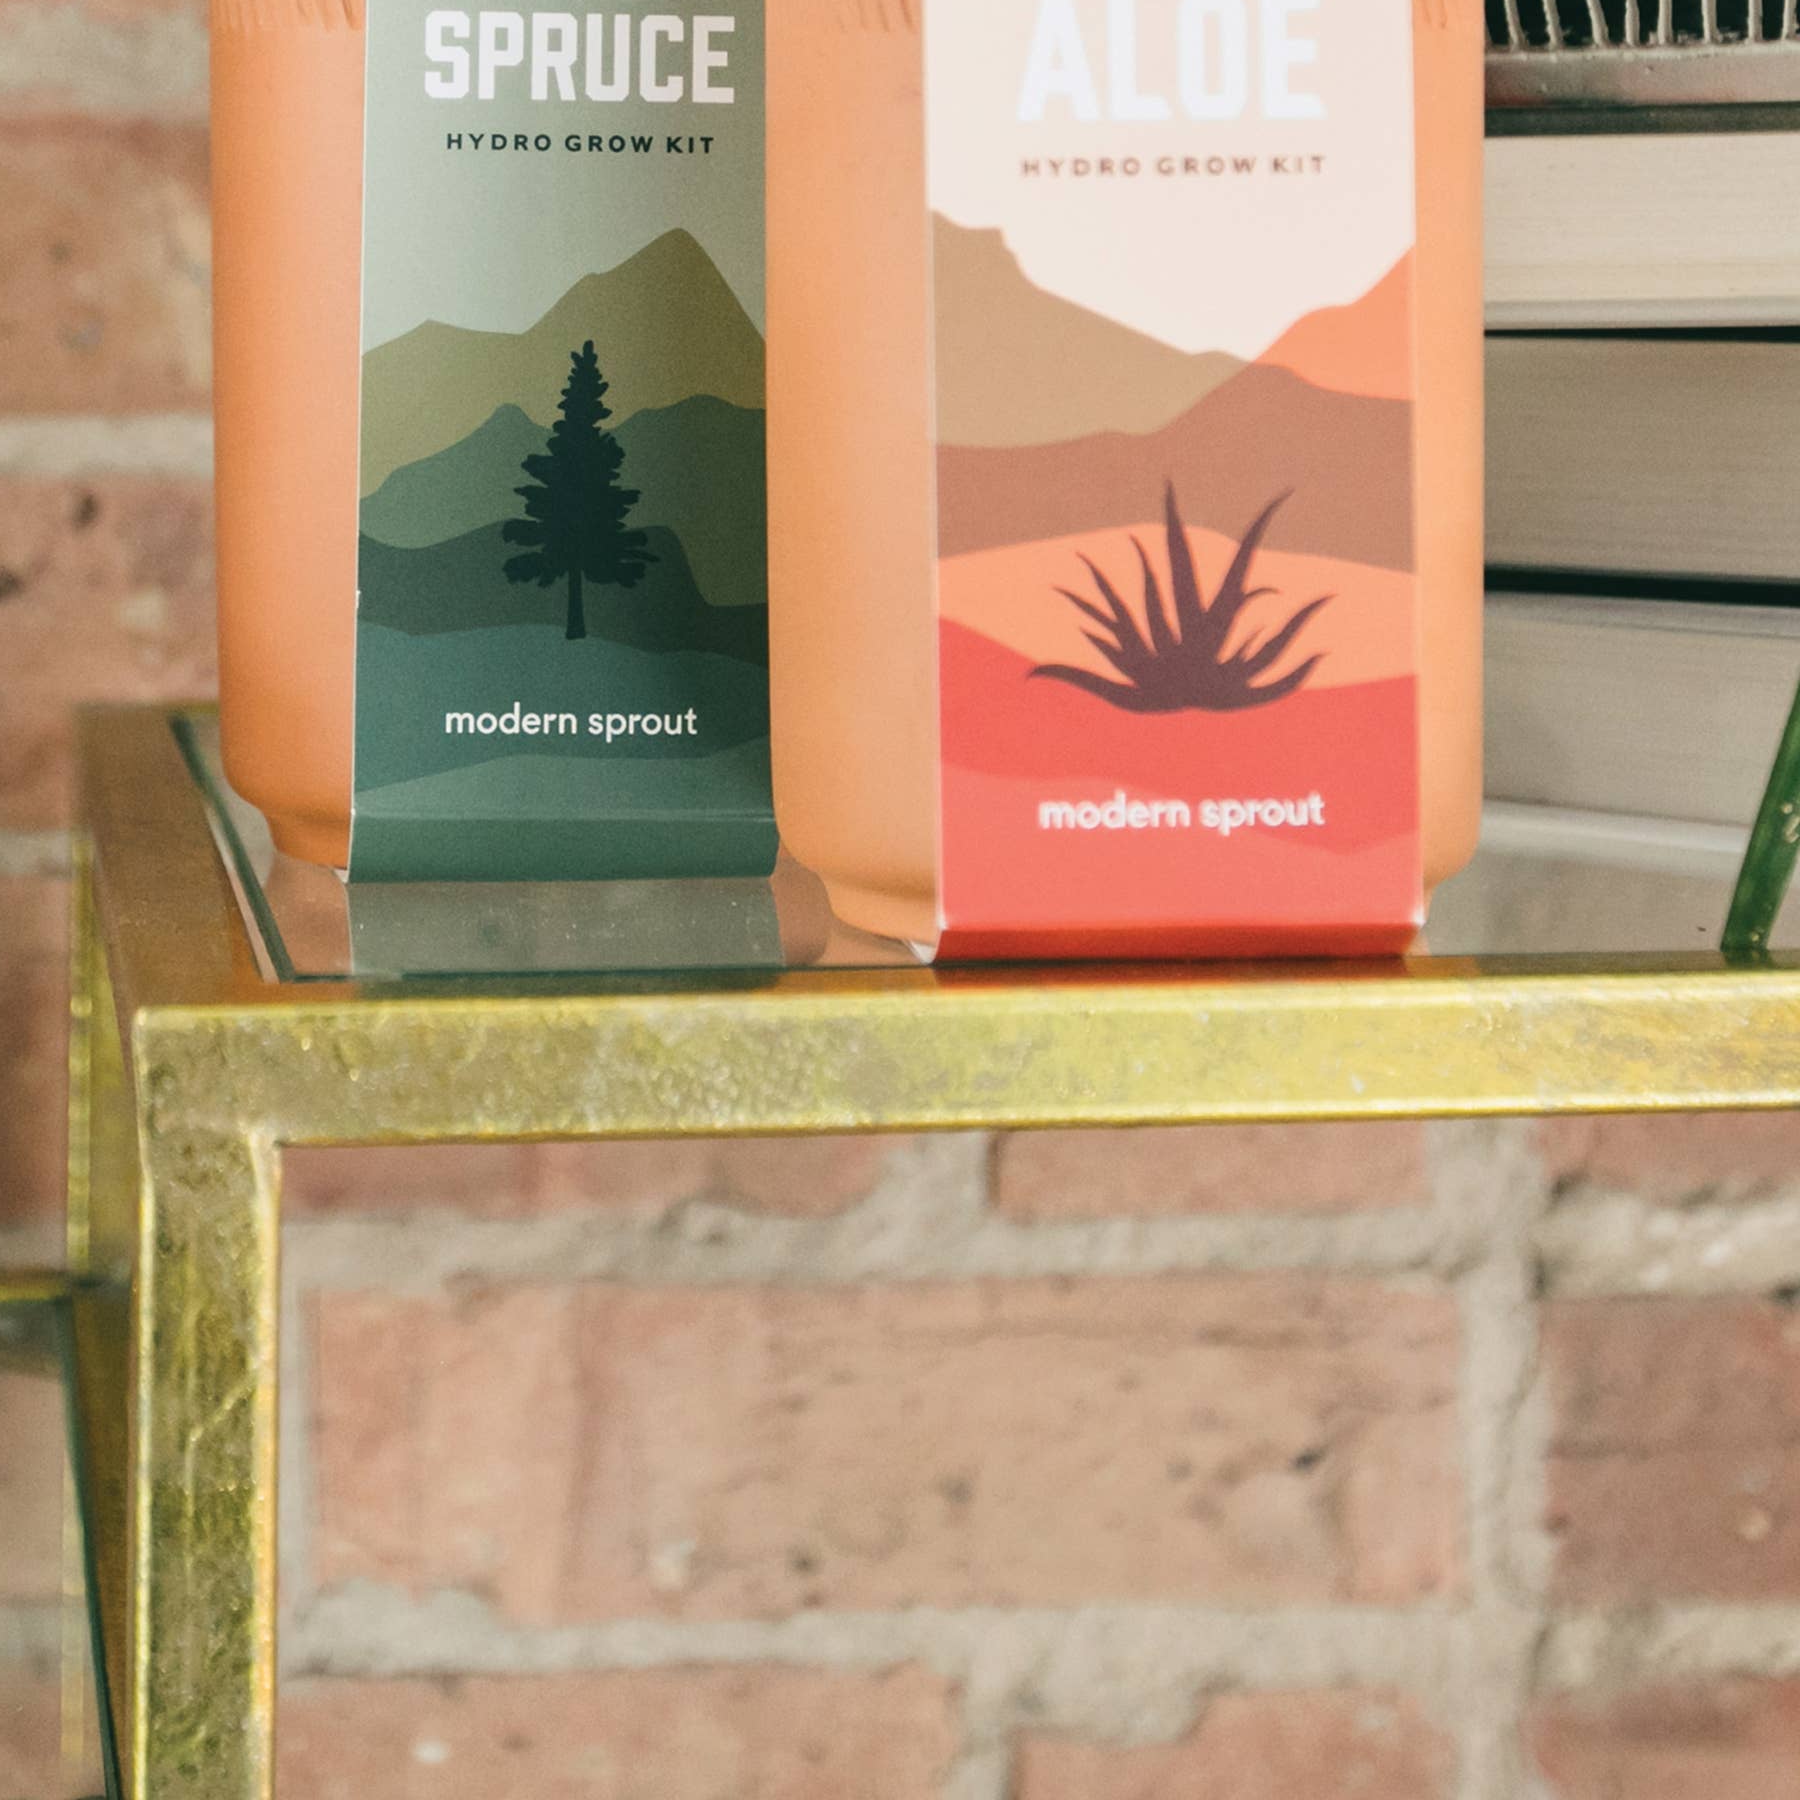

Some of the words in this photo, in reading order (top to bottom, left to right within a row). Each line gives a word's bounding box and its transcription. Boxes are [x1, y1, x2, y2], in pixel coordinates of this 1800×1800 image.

[424, 10, 736, 104] SPRUCE
[446, 133, 552, 151] HYDRO
[564, 134, 654, 153] GROW
[665, 136, 715, 154] KIT
[1020, 156, 1142, 177] HYDRO
[1155, 155, 1257, 176] GROW
[1270, 154, 1327, 174] KIT
[444, 701, 578, 735] modern
[587, 707, 698, 744] sprout
[1037, 788, 1191, 829] modern
[1200, 792, 1326, 837] sprout
